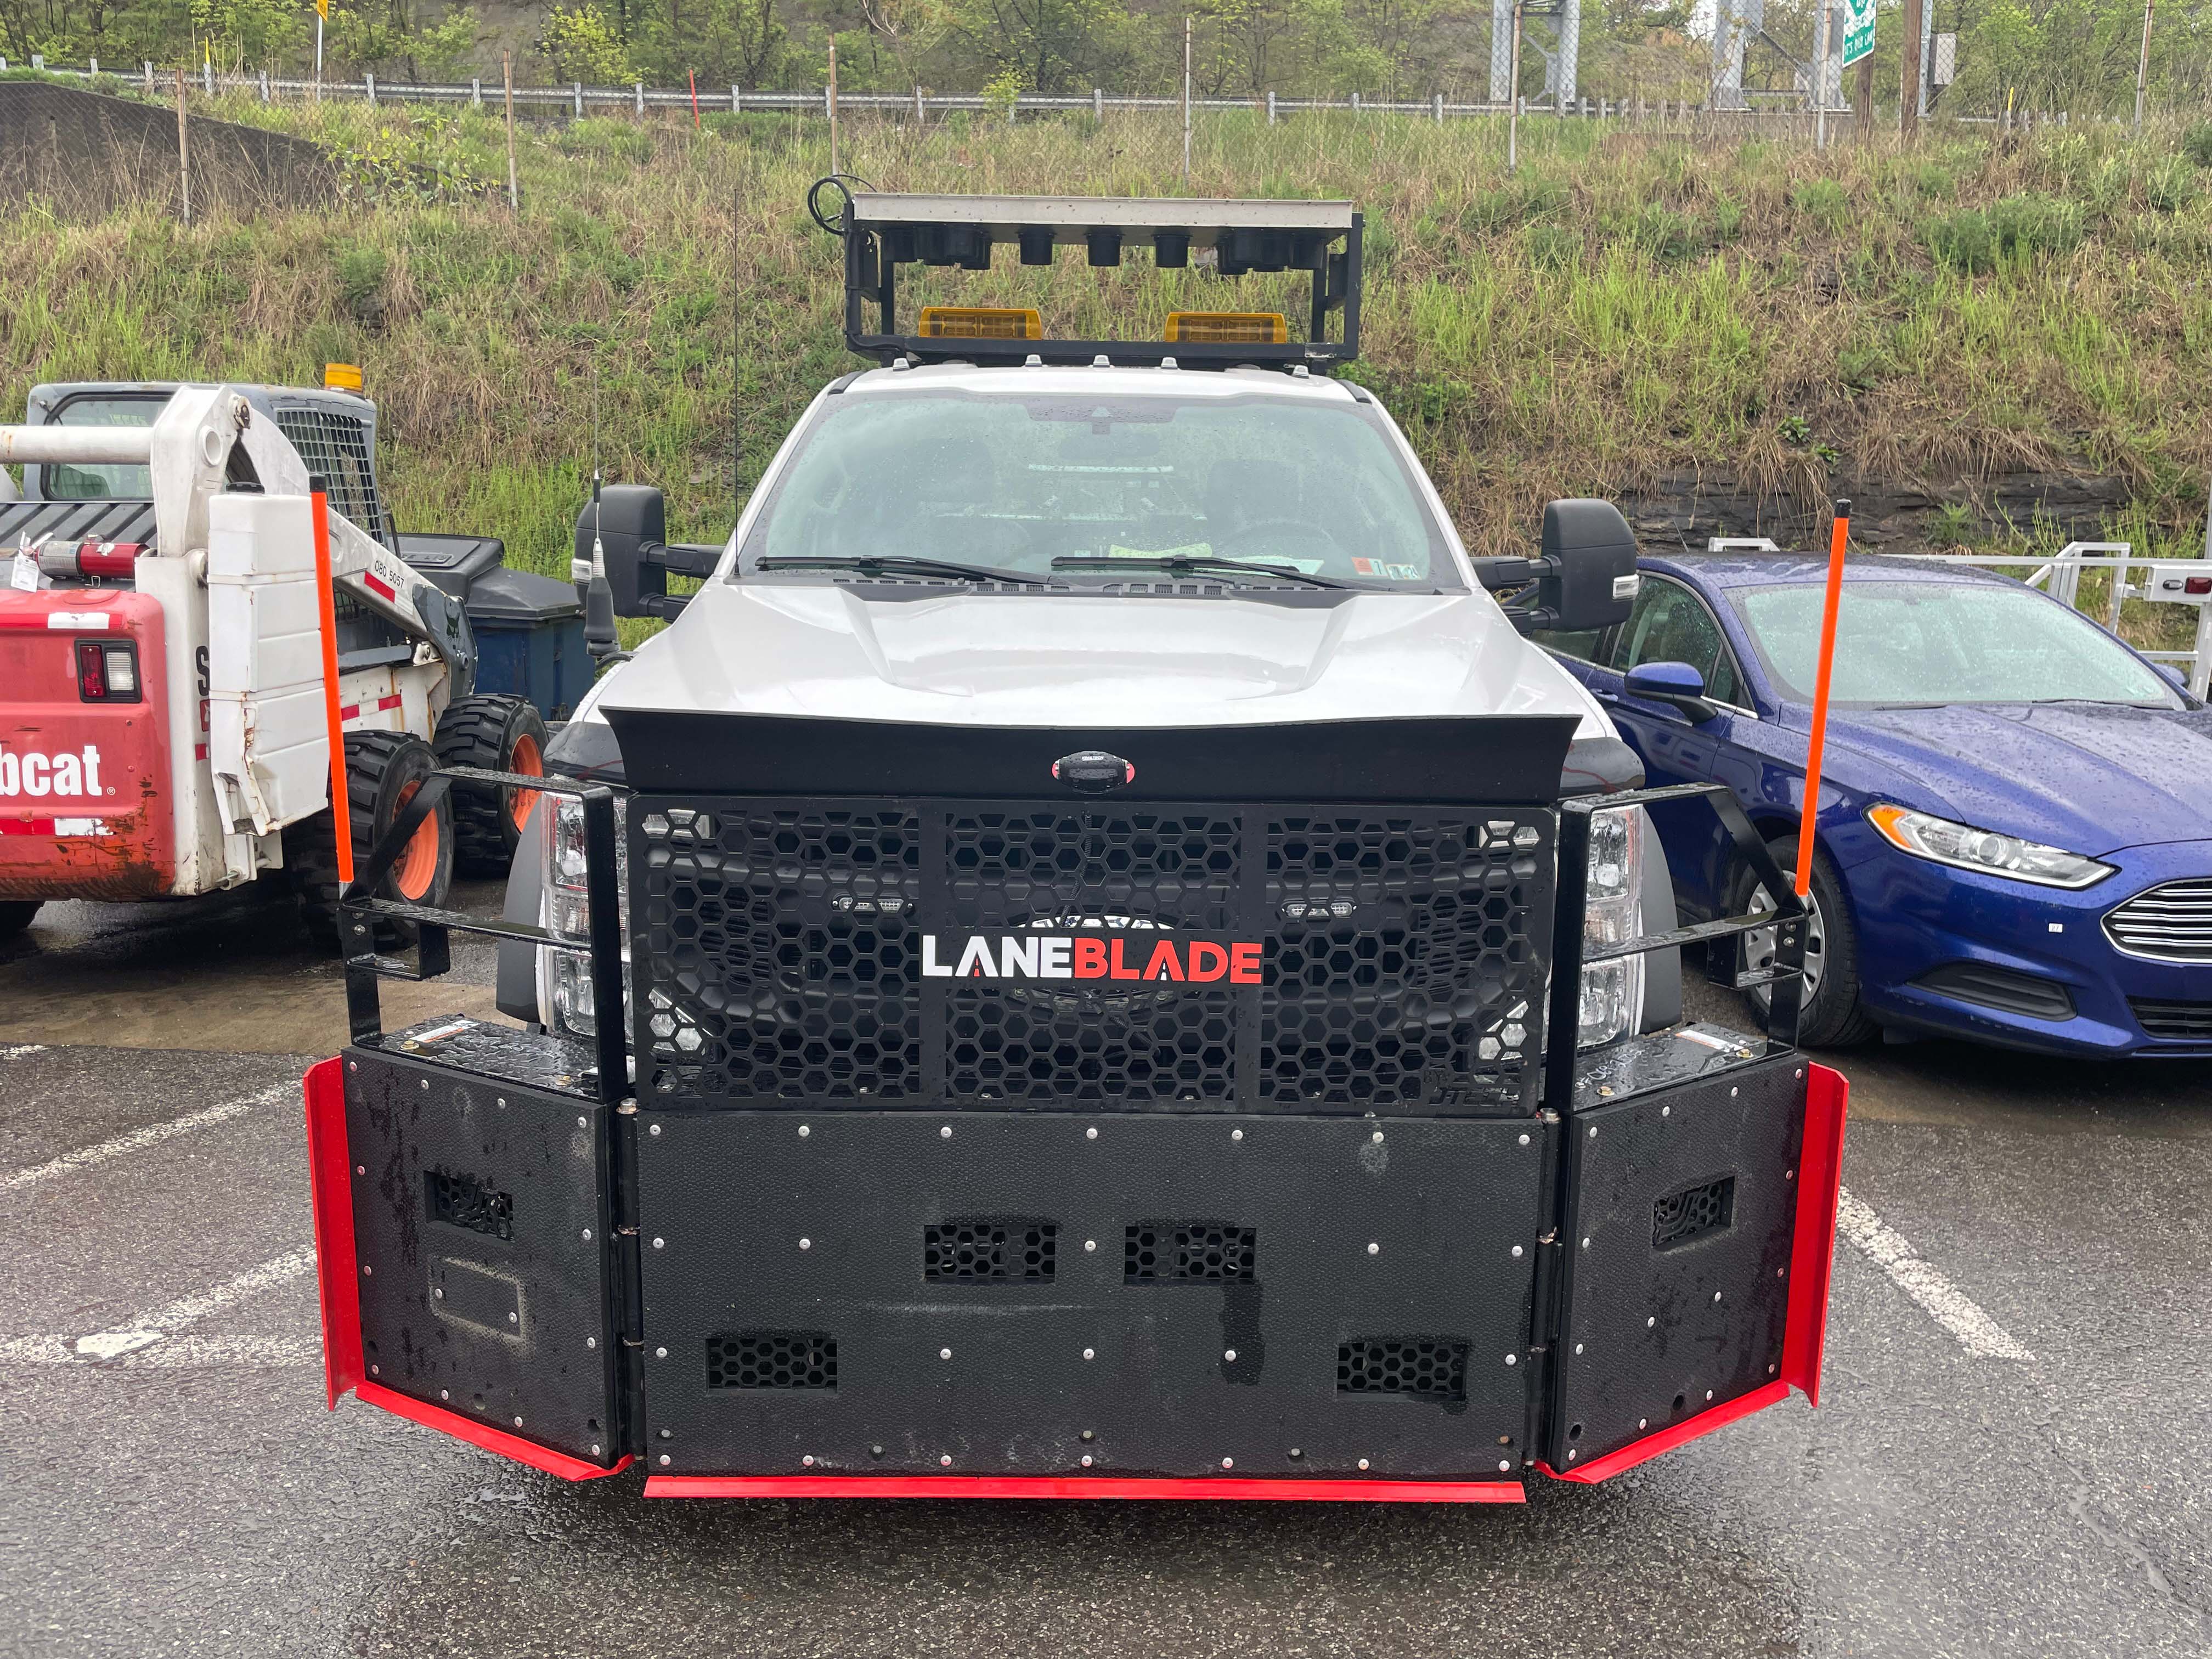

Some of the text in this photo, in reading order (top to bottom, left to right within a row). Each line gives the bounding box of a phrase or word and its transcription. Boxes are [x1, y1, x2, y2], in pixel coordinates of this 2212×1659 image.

[375, 560, 404, 589] 080 5057
[922, 935, 1262, 984] LANEBLADE
